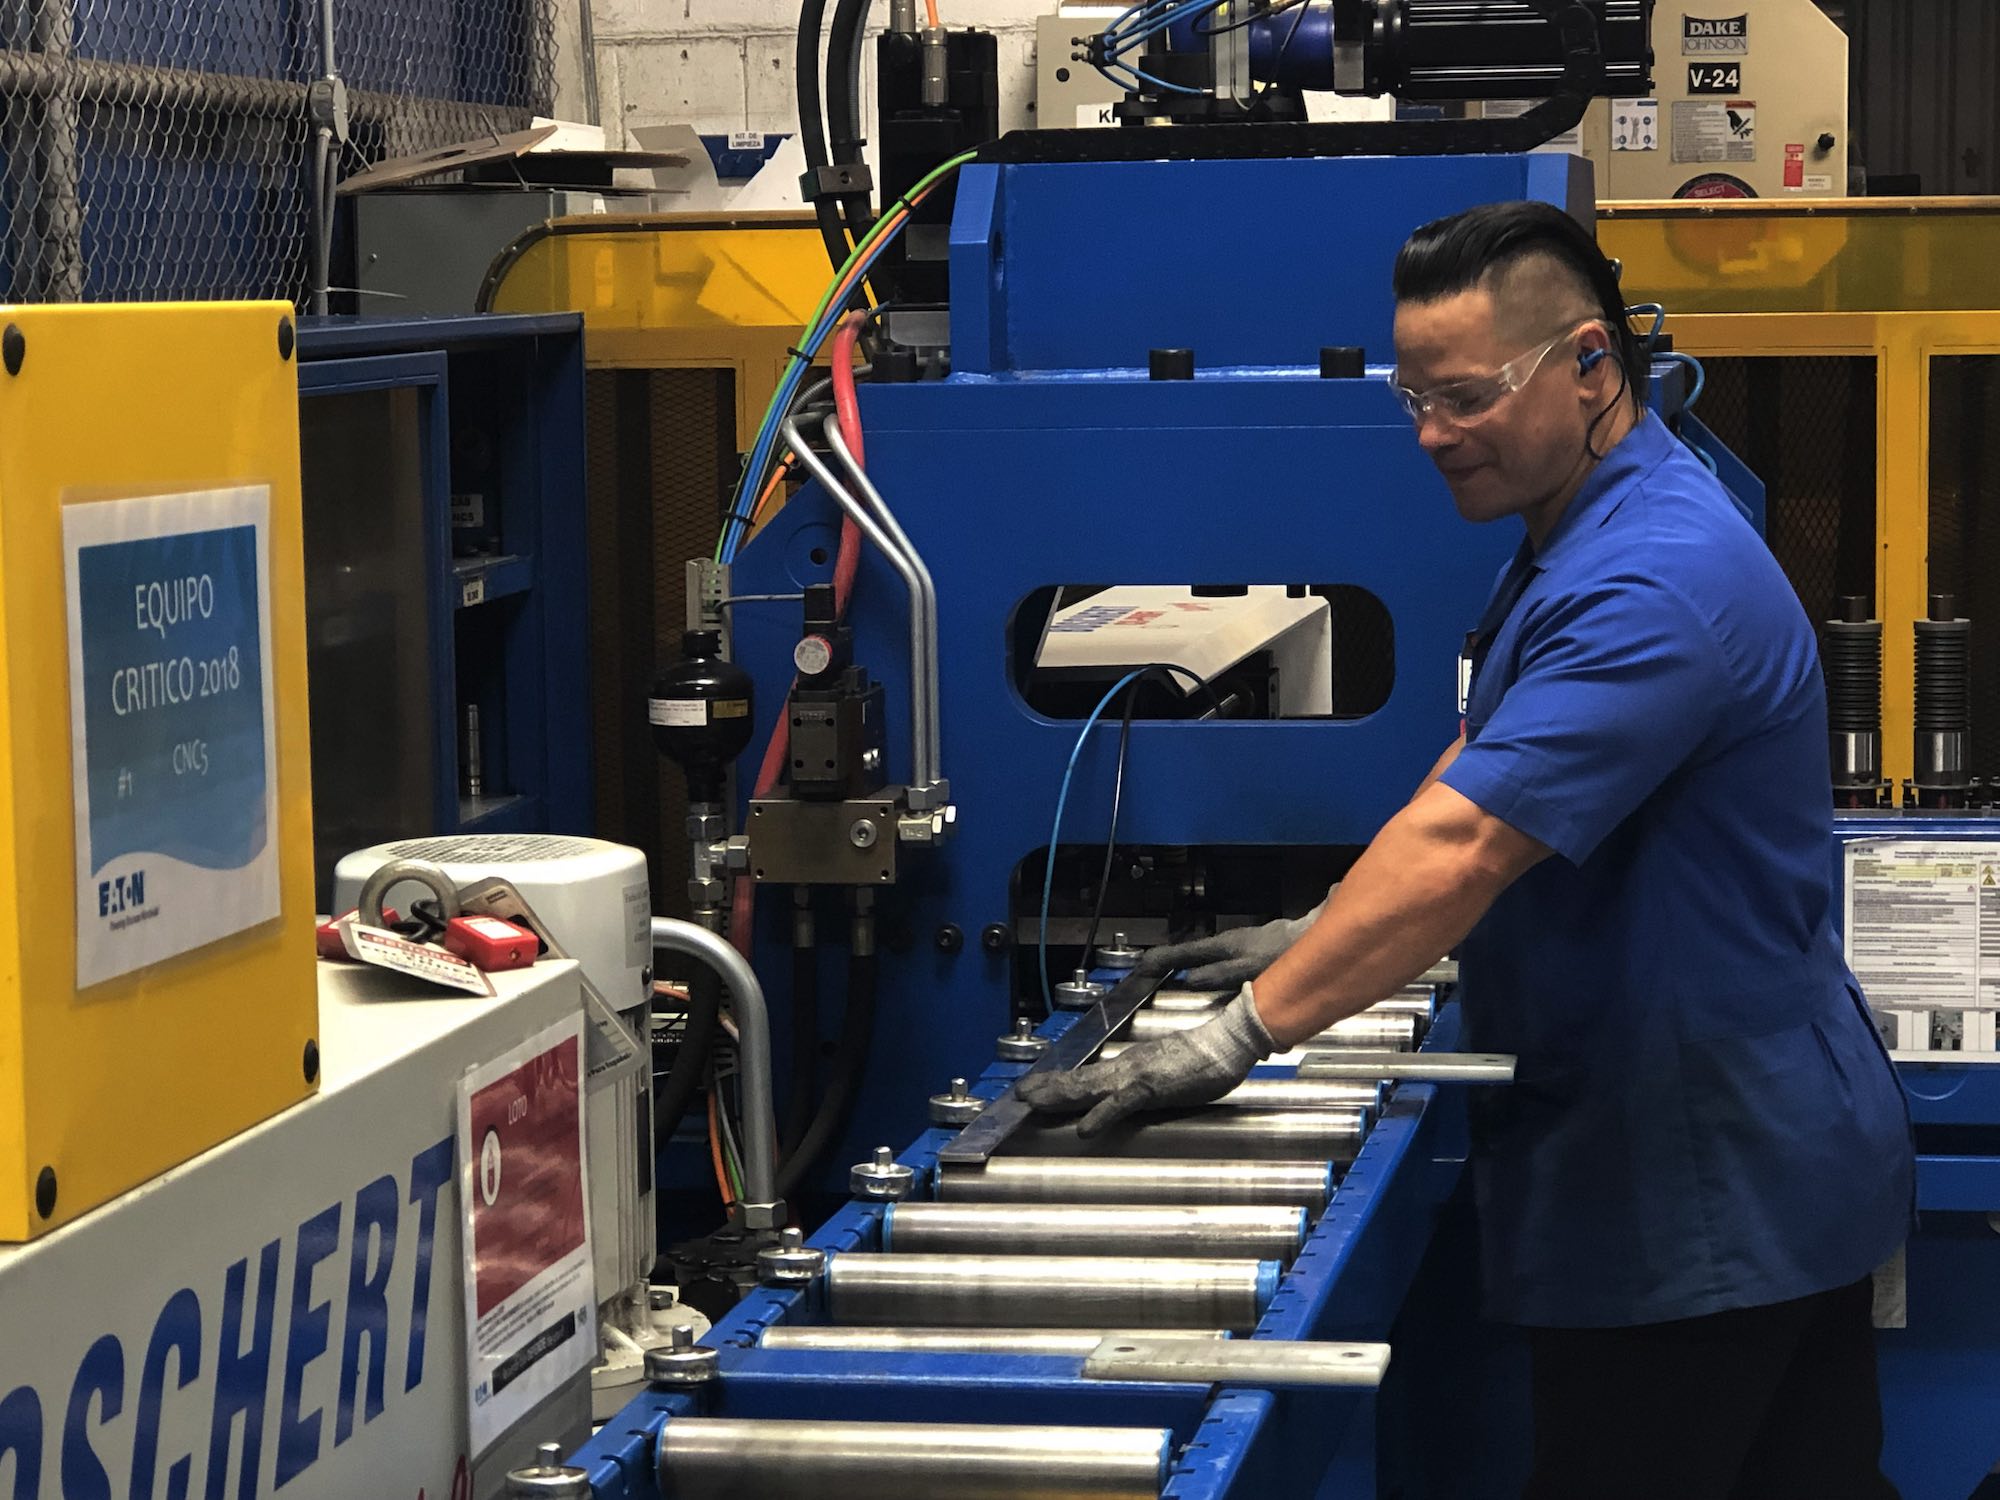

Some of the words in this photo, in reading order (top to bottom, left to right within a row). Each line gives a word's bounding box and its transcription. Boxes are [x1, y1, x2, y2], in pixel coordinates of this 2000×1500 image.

[1689, 21, 1741, 36] DAKE
[1684, 37, 1747, 51] JOHNSON
[1690, 68, 1739, 88] V-24
[731, 140, 761, 148] LIMPIEZA
[735, 132, 746, 140] KIT
[1694, 185, 1726, 197] SELECT
[135, 574, 213, 639] EQUIPO
[112, 656, 194, 715] CRITICO
[199, 645, 241, 697] 2018
[172, 739, 209, 776] CNC5
[117, 766, 134, 799] #1
[508, 1094, 528, 1126] LOTO
